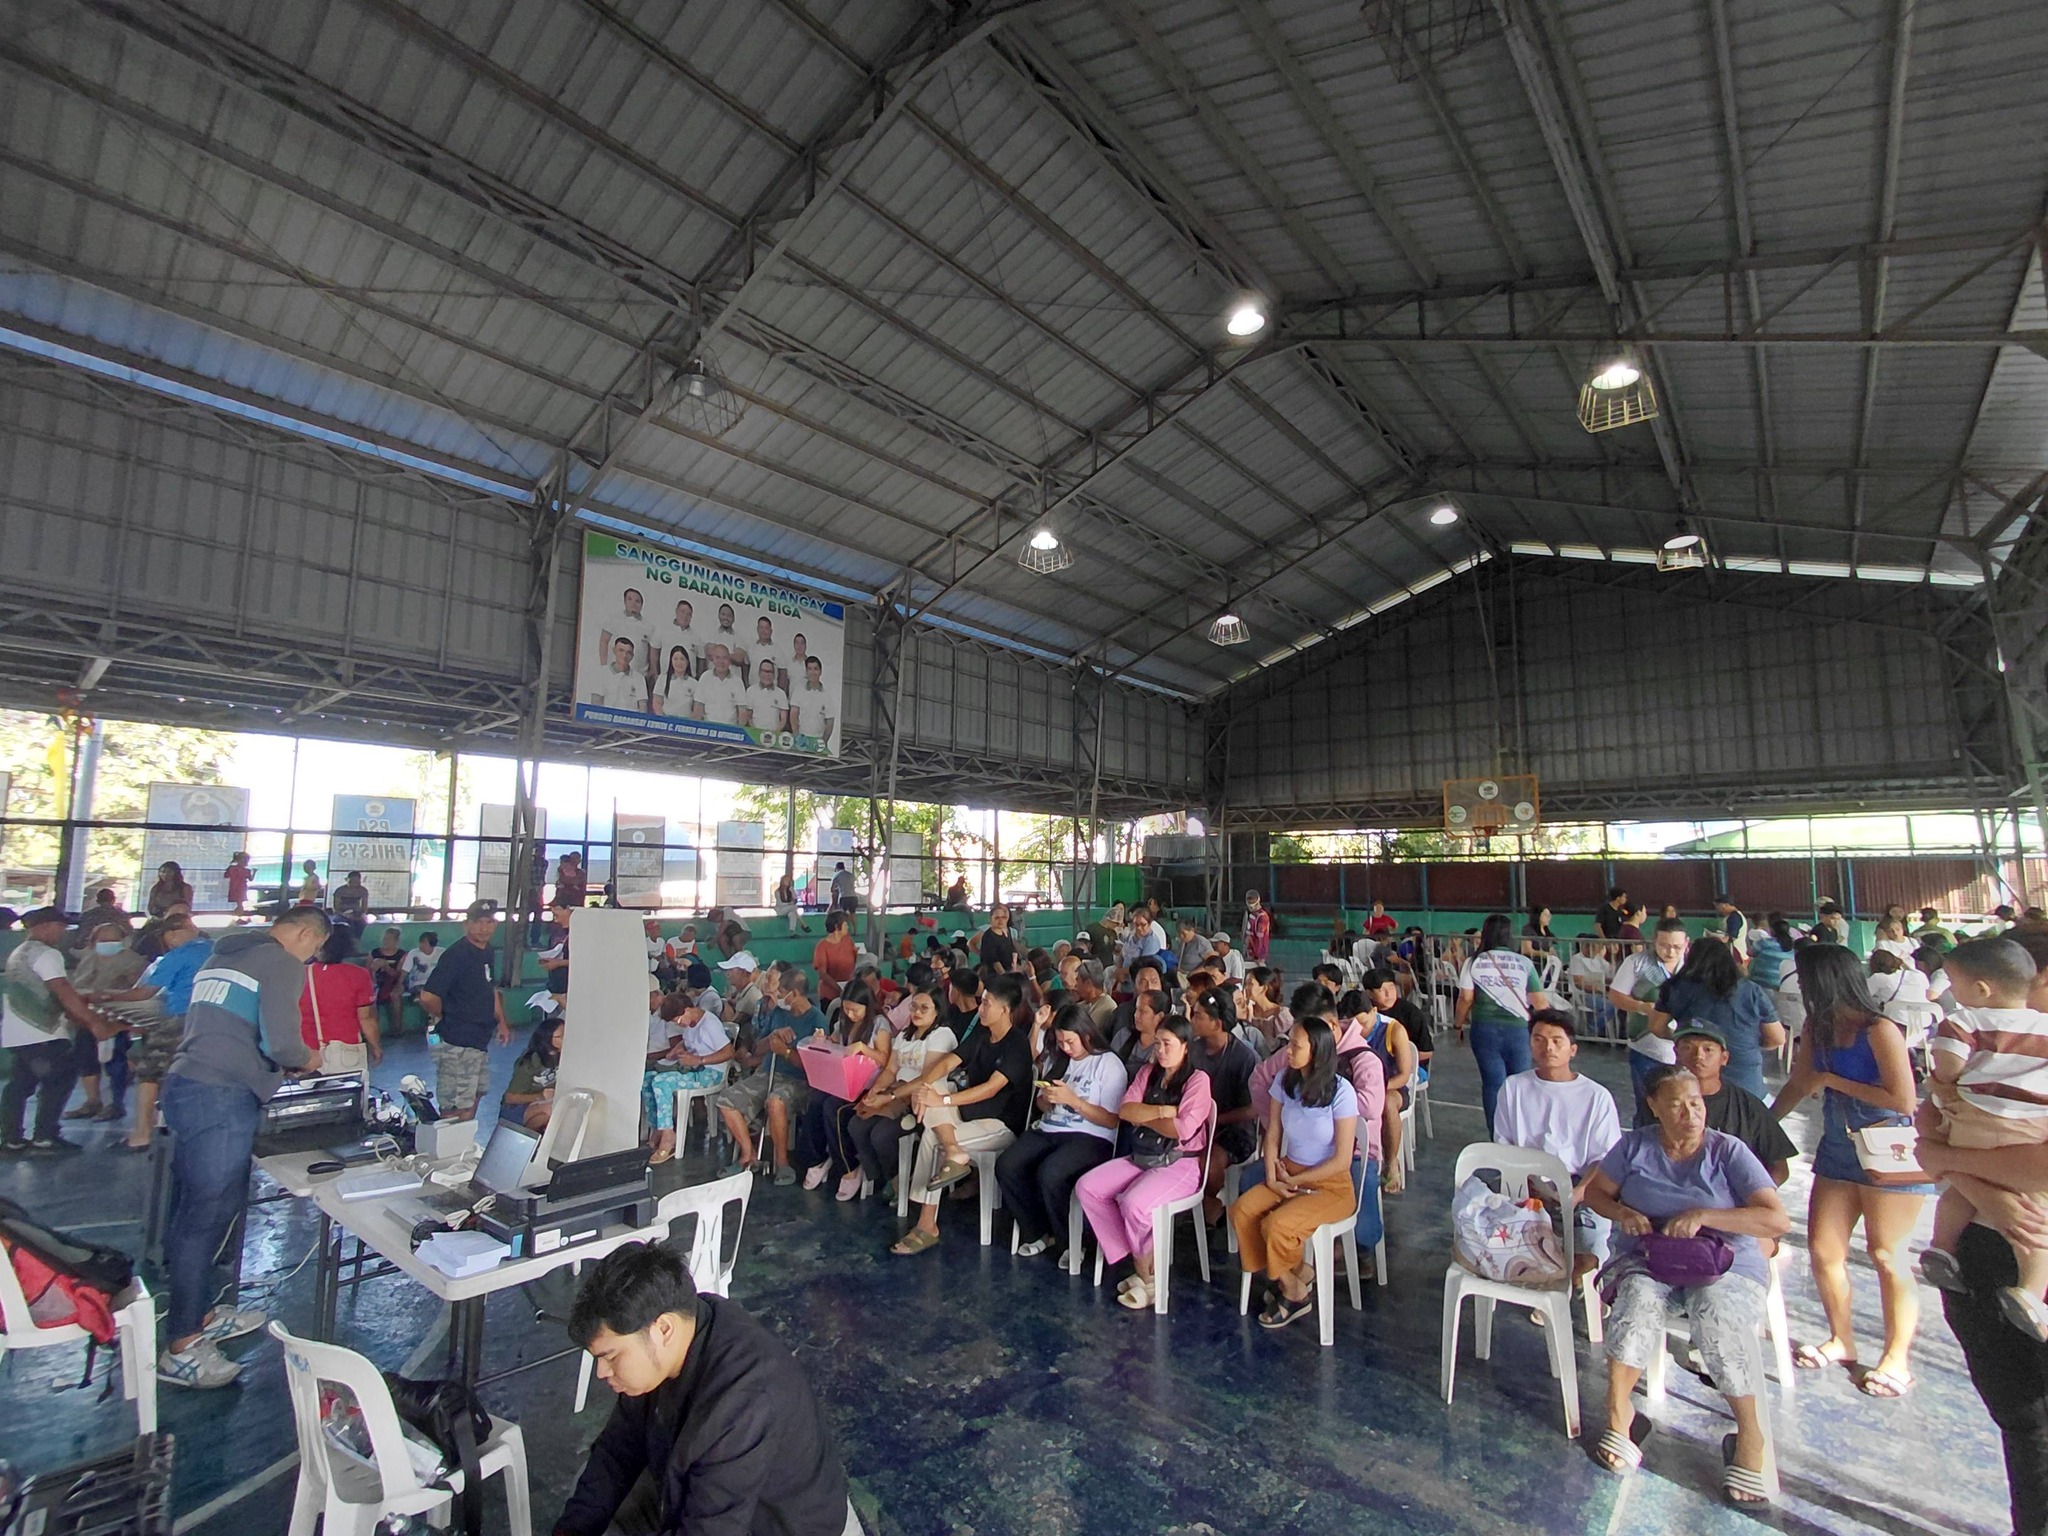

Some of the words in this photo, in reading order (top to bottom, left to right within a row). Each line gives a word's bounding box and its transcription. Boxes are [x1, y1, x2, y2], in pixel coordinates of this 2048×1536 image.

[617, 543, 746, 590] SANGGUNIANG
[750, 581, 827, 612] BARANGAY
[646, 568, 673, 585] NG
[678, 575, 764, 609] BARANGAY
[768, 600, 802, 620] BIGA
